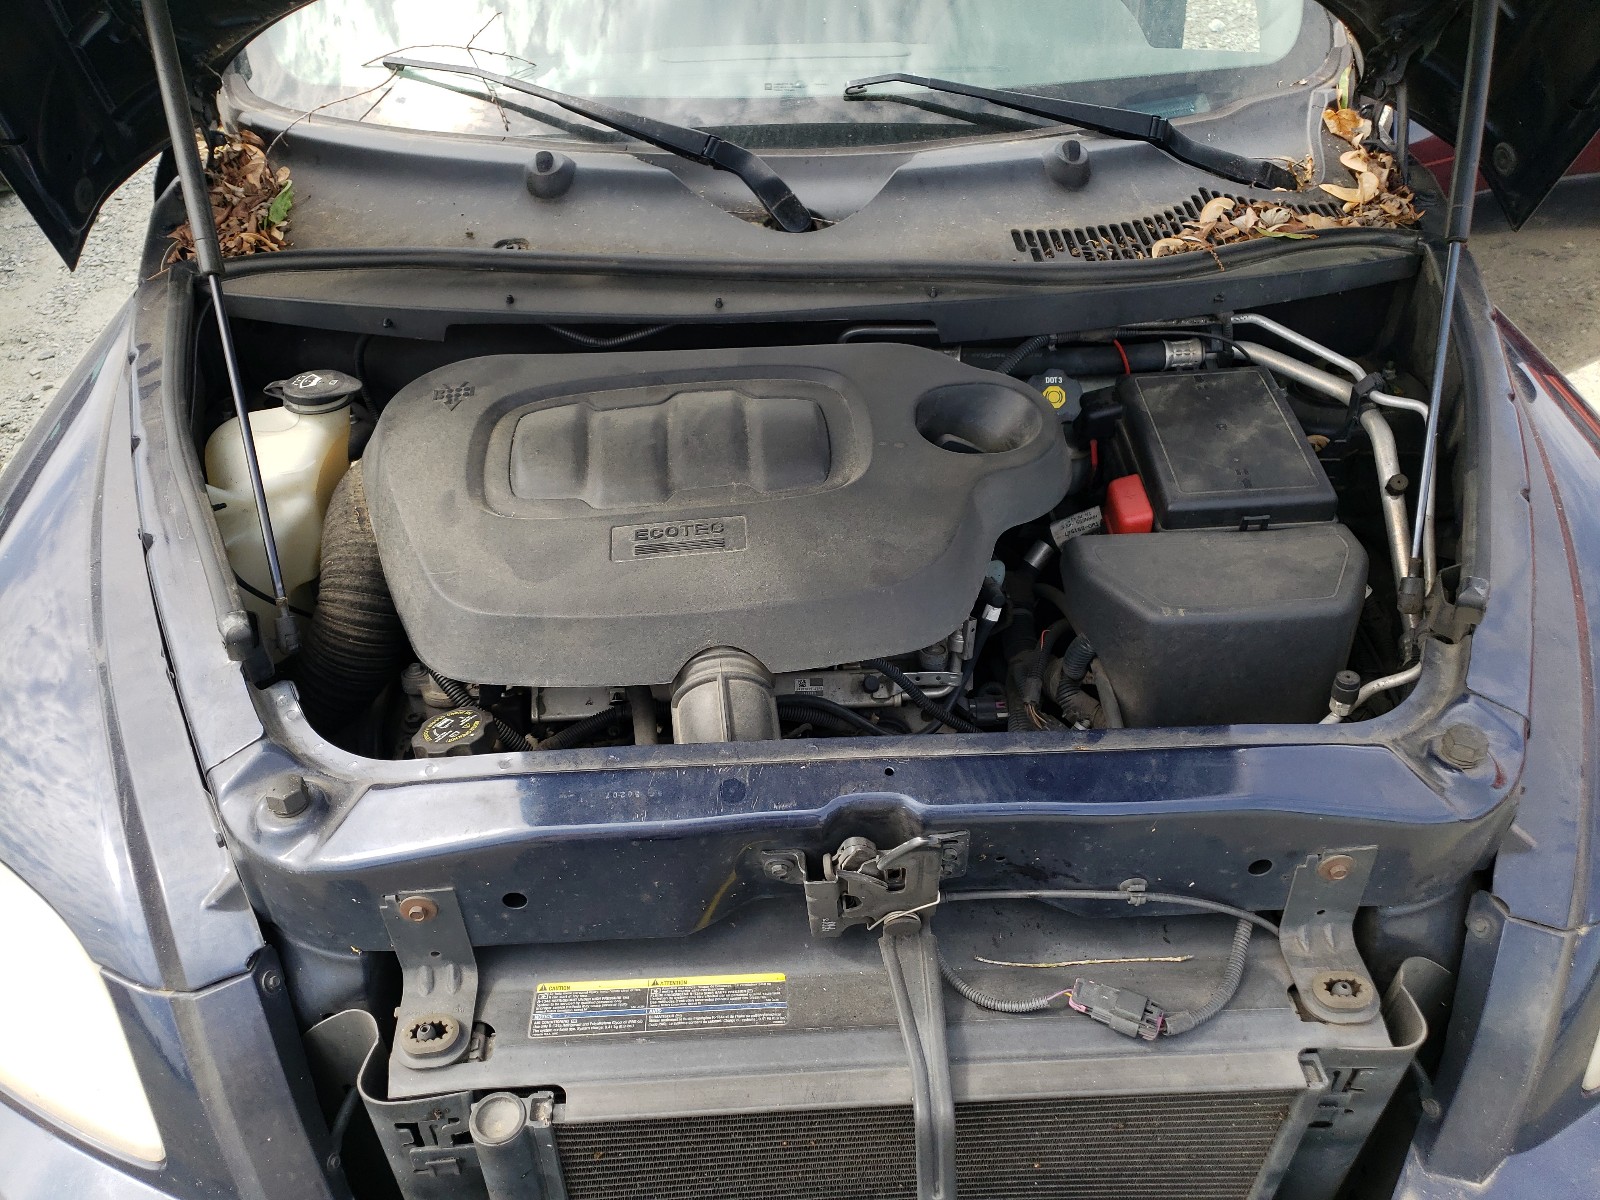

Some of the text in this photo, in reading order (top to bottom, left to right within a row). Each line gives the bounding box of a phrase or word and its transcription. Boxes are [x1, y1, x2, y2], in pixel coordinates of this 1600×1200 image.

[1045, 376, 1063, 384] DOT 3
[634, 521, 724, 541] ECOTEC
